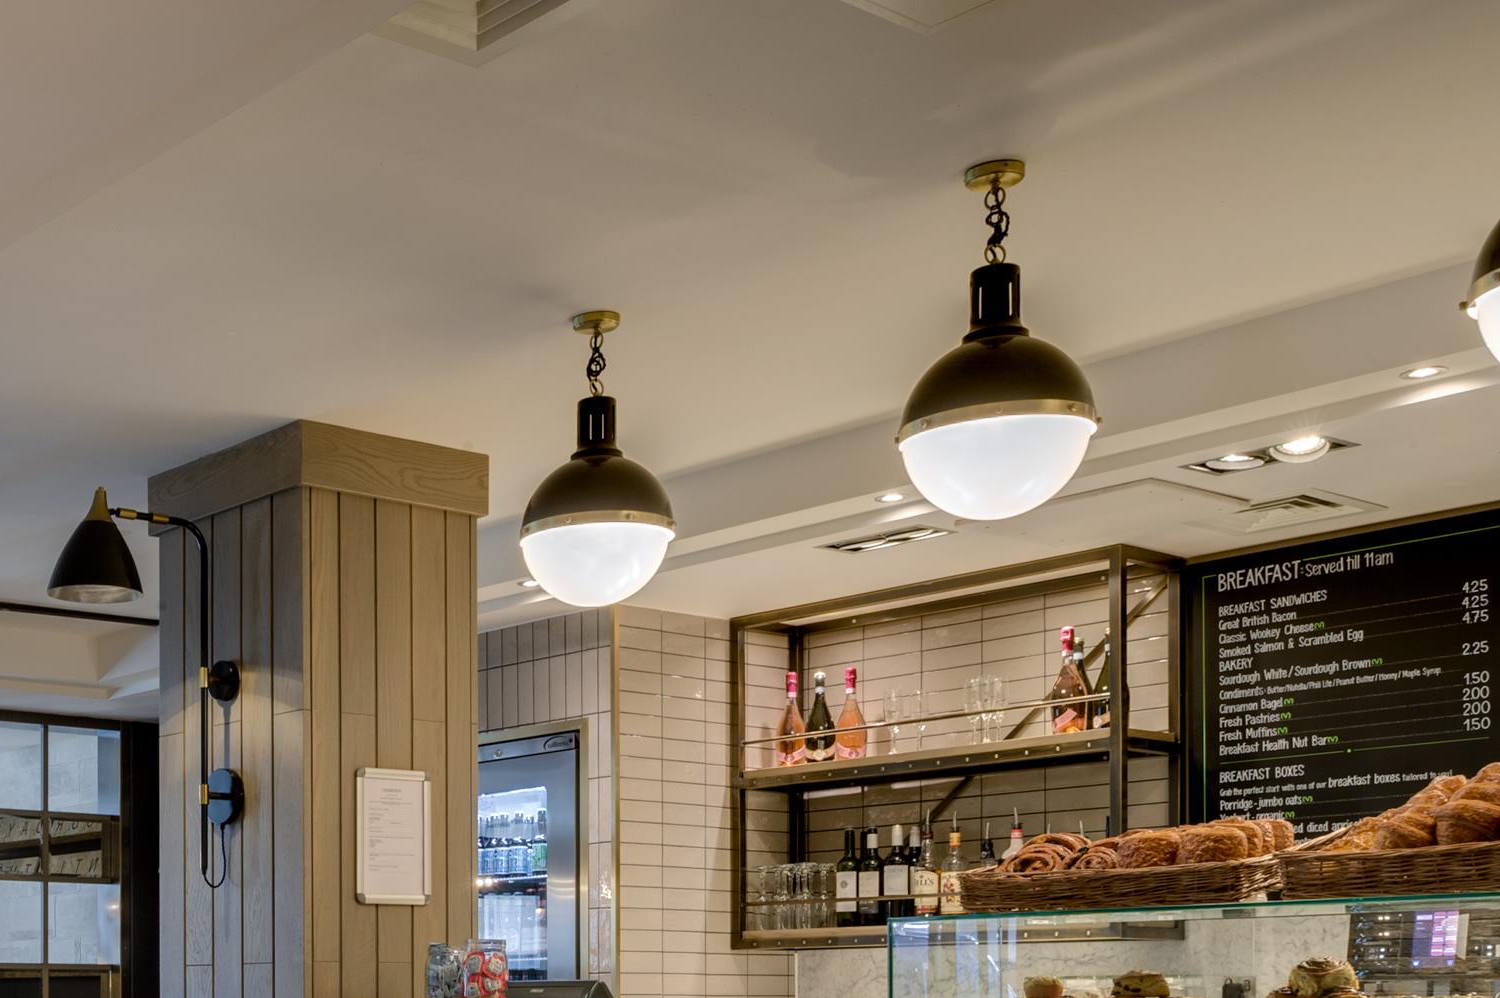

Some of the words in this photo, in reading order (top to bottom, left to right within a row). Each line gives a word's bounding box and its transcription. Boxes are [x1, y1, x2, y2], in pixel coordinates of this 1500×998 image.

[1305, 556, 1344, 577] Served
[1346, 554, 1360, 571] till
[1364, 551, 1394, 567] 11am
[1218, 599, 1266, 617] BREAKFAST
[1270, 589, 1328, 609] SANDWICHES
[1218, 619, 1240, 631] Great
[1242, 613, 1270, 628] British
[1271, 610, 1297, 623] Bacon
[1219, 632, 1247, 645] Classic
[1249, 627, 1281, 641] Wookey
[1284, 623, 1314, 636] Cheese
[1219, 645, 1251, 659] Smoked
[1254, 640, 1284, 654] Salmon
[1288, 638, 1295, 649] &
[1298, 631, 1344, 648] Scrambled
[1347, 629, 1364, 642] Egg
[1219, 671, 1261, 686] Sourdough
[1342, 658, 1372, 671] Brown
[1461, 640, 1490, 656] 2.25
[1219, 657, 1254, 672] BAKERY
[1219, 702, 1258, 714] Cinnamon
[1260, 697, 1284, 711] Bagel
[1219, 717, 1243, 729] Fresh
[1245, 712, 1280, 725] Pastries
[1219, 729, 1243, 742] Fresh
[1245, 726, 1277, 739] Muffins
[1219, 741, 1260, 756] Breakfast
[1262, 738, 1289, 752] Health
[1292, 736, 1308, 749] Nut
[1311, 734, 1327, 746] Bar
[1219, 767, 1271, 783] BREAKFAST
[1275, 764, 1305, 779] BOXES
[1220, 788, 1233, 797] Grab
[1233, 787, 1243, 795] the
[1243, 785, 1264, 797] perfect
[1265, 784, 1280, 793] start
[1281, 783, 1295, 791] with
[1308, 781, 1315, 789] of
[1315, 781, 1328, 789] our
[1328, 773, 1372, 788] breakfast
[1373, 772, 1401, 784] boxes
[1402, 771, 1428, 781] tailored
[1219, 797, 1253, 812] Porridge
[1257, 796, 1283, 810] jumbo
[1285, 795, 1302, 805] oats
[1306, 820, 1329, 833] diced
